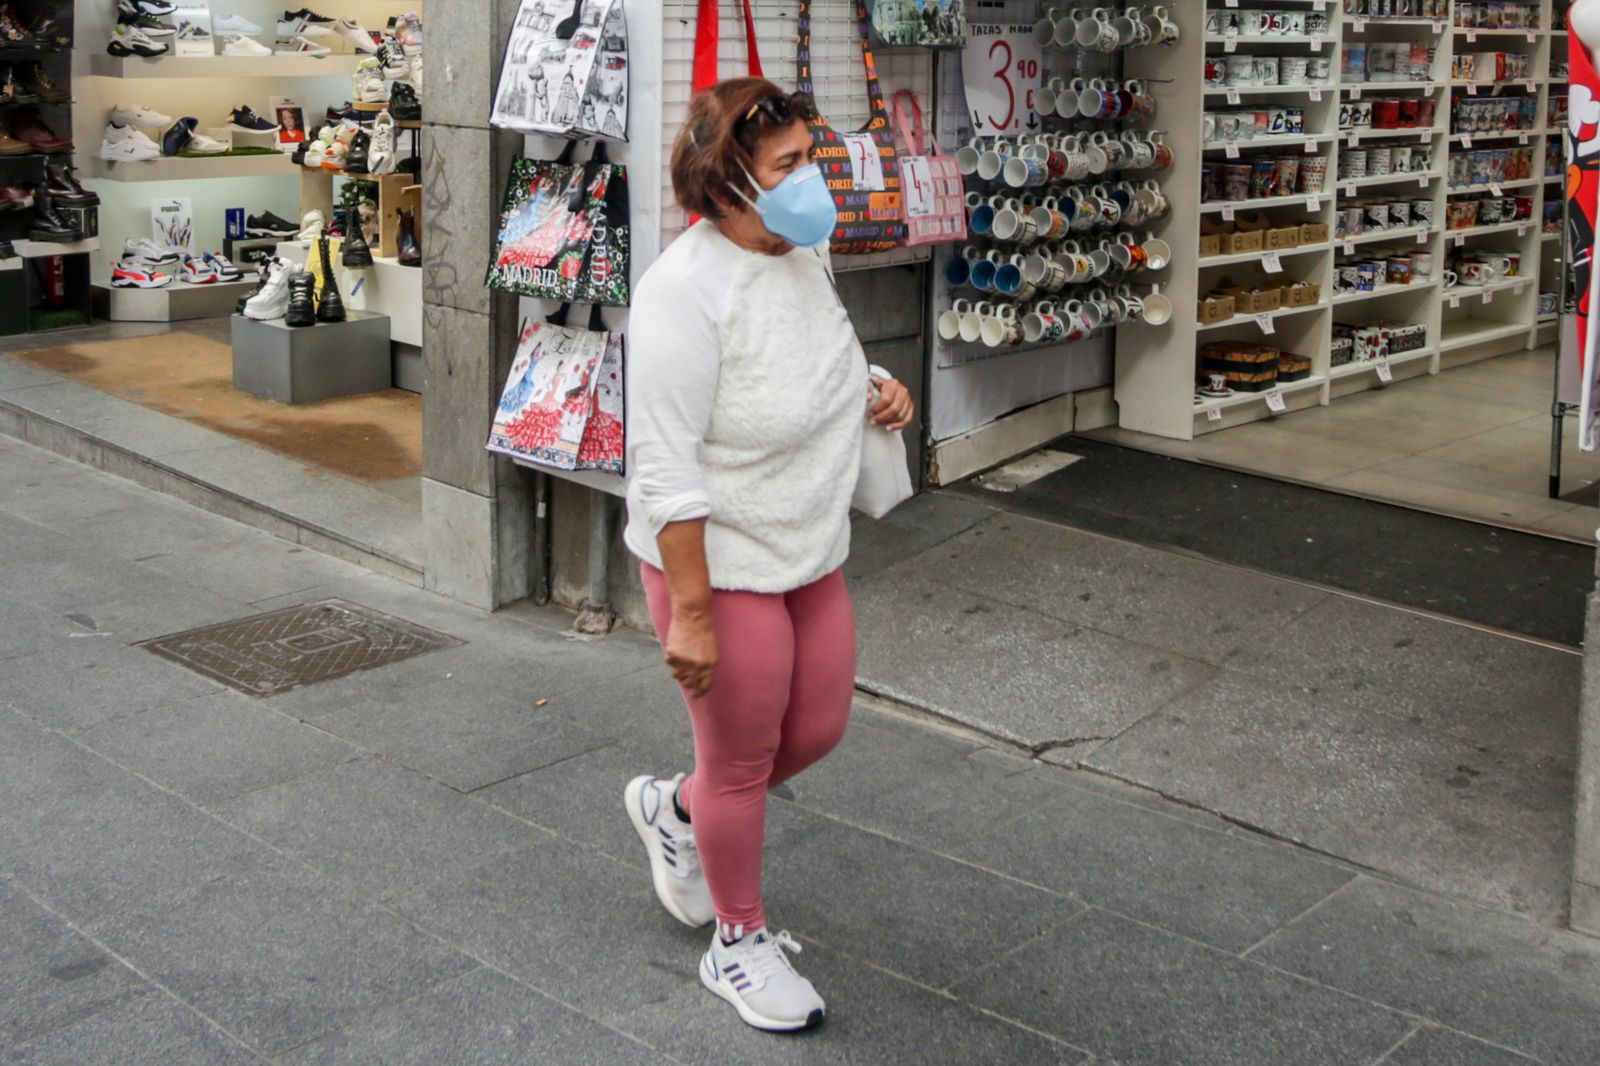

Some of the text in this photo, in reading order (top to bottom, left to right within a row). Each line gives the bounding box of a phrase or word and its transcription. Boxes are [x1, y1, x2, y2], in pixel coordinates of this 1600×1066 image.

[971, 25, 1002, 36] TAZAS
[1017, 60, 1038, 79] 90
[501, 264, 558, 287] MADRID
